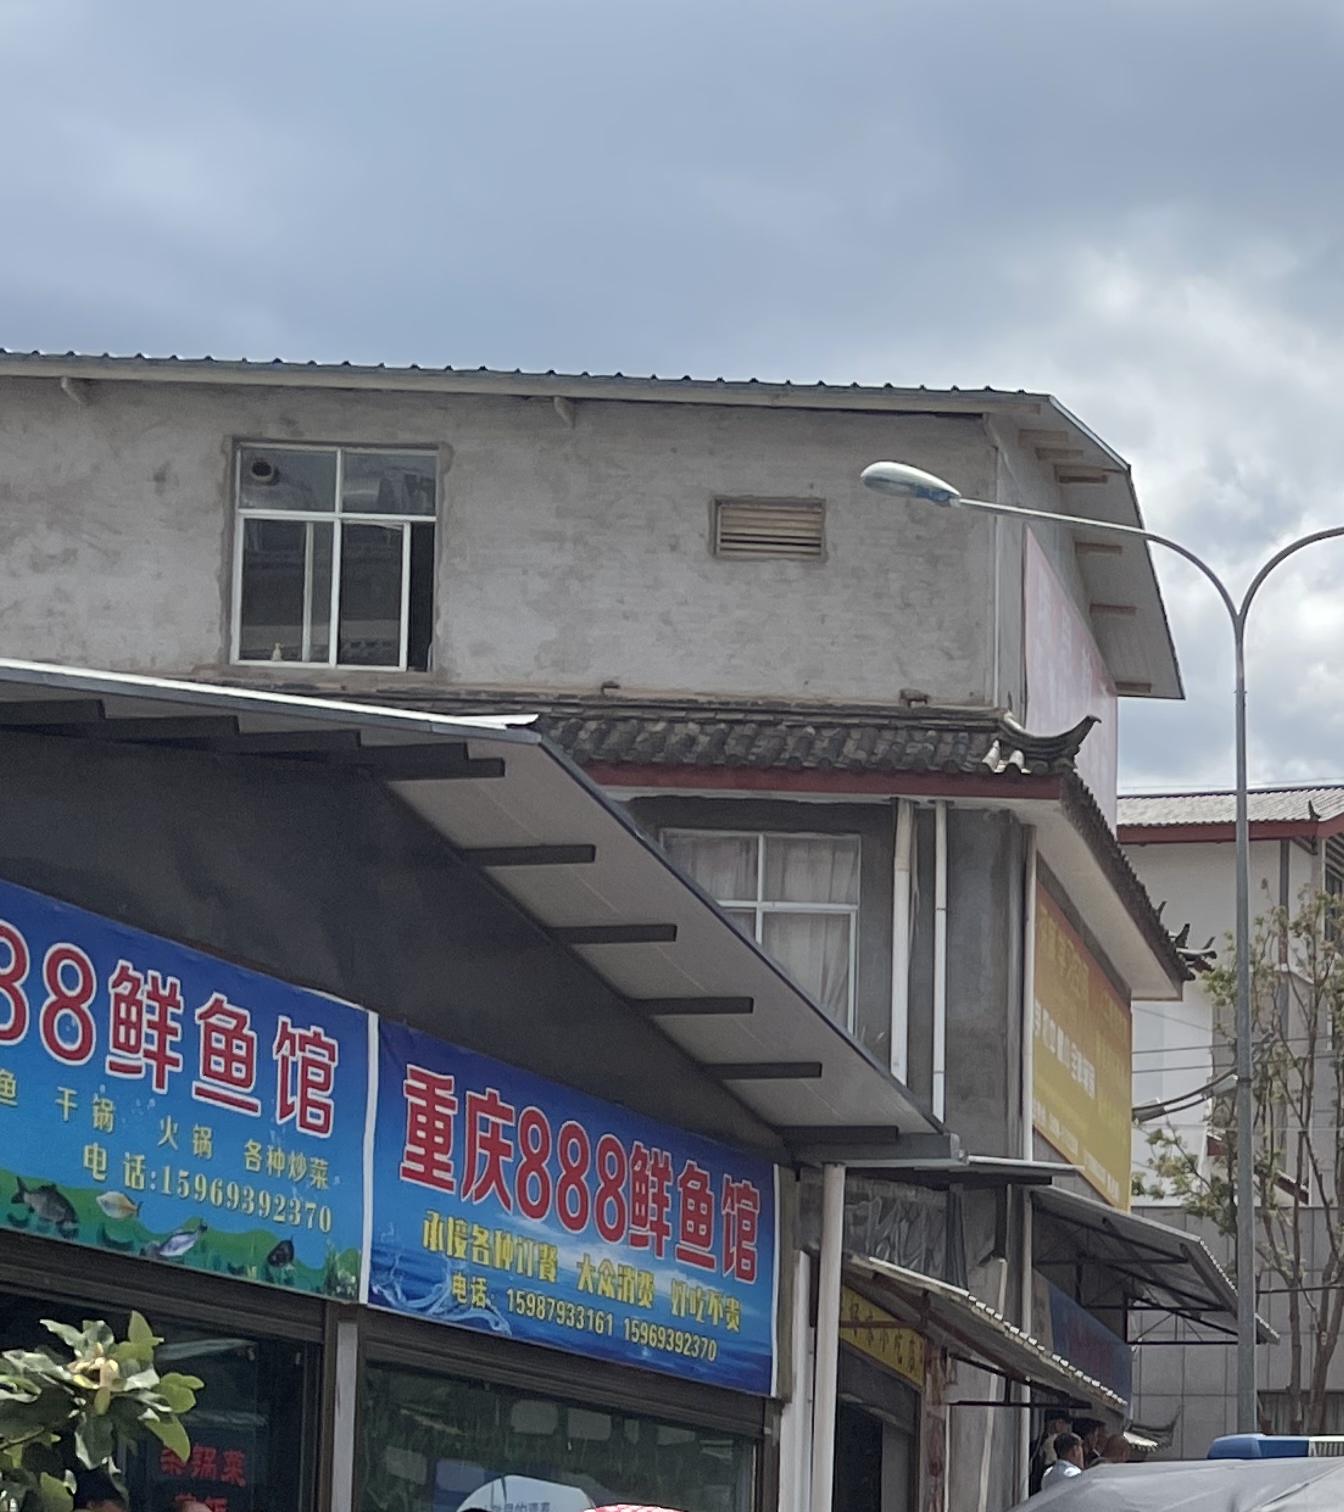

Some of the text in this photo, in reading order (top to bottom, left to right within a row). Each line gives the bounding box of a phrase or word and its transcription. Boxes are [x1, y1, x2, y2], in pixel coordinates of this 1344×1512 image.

[158, 1115, 213, 1160] 火锅
[244, 1139, 330, 1190] 各种炒菜
[400, 1064, 760, 1283] 重庆888鲜鱼馆
[422, 1210, 741, 1332] 承接各种订餐 大众消费 好吃不贵
[506, 1288, 614, 1337] 15987933161
[623, 1317, 717, 1363] 15969392370
